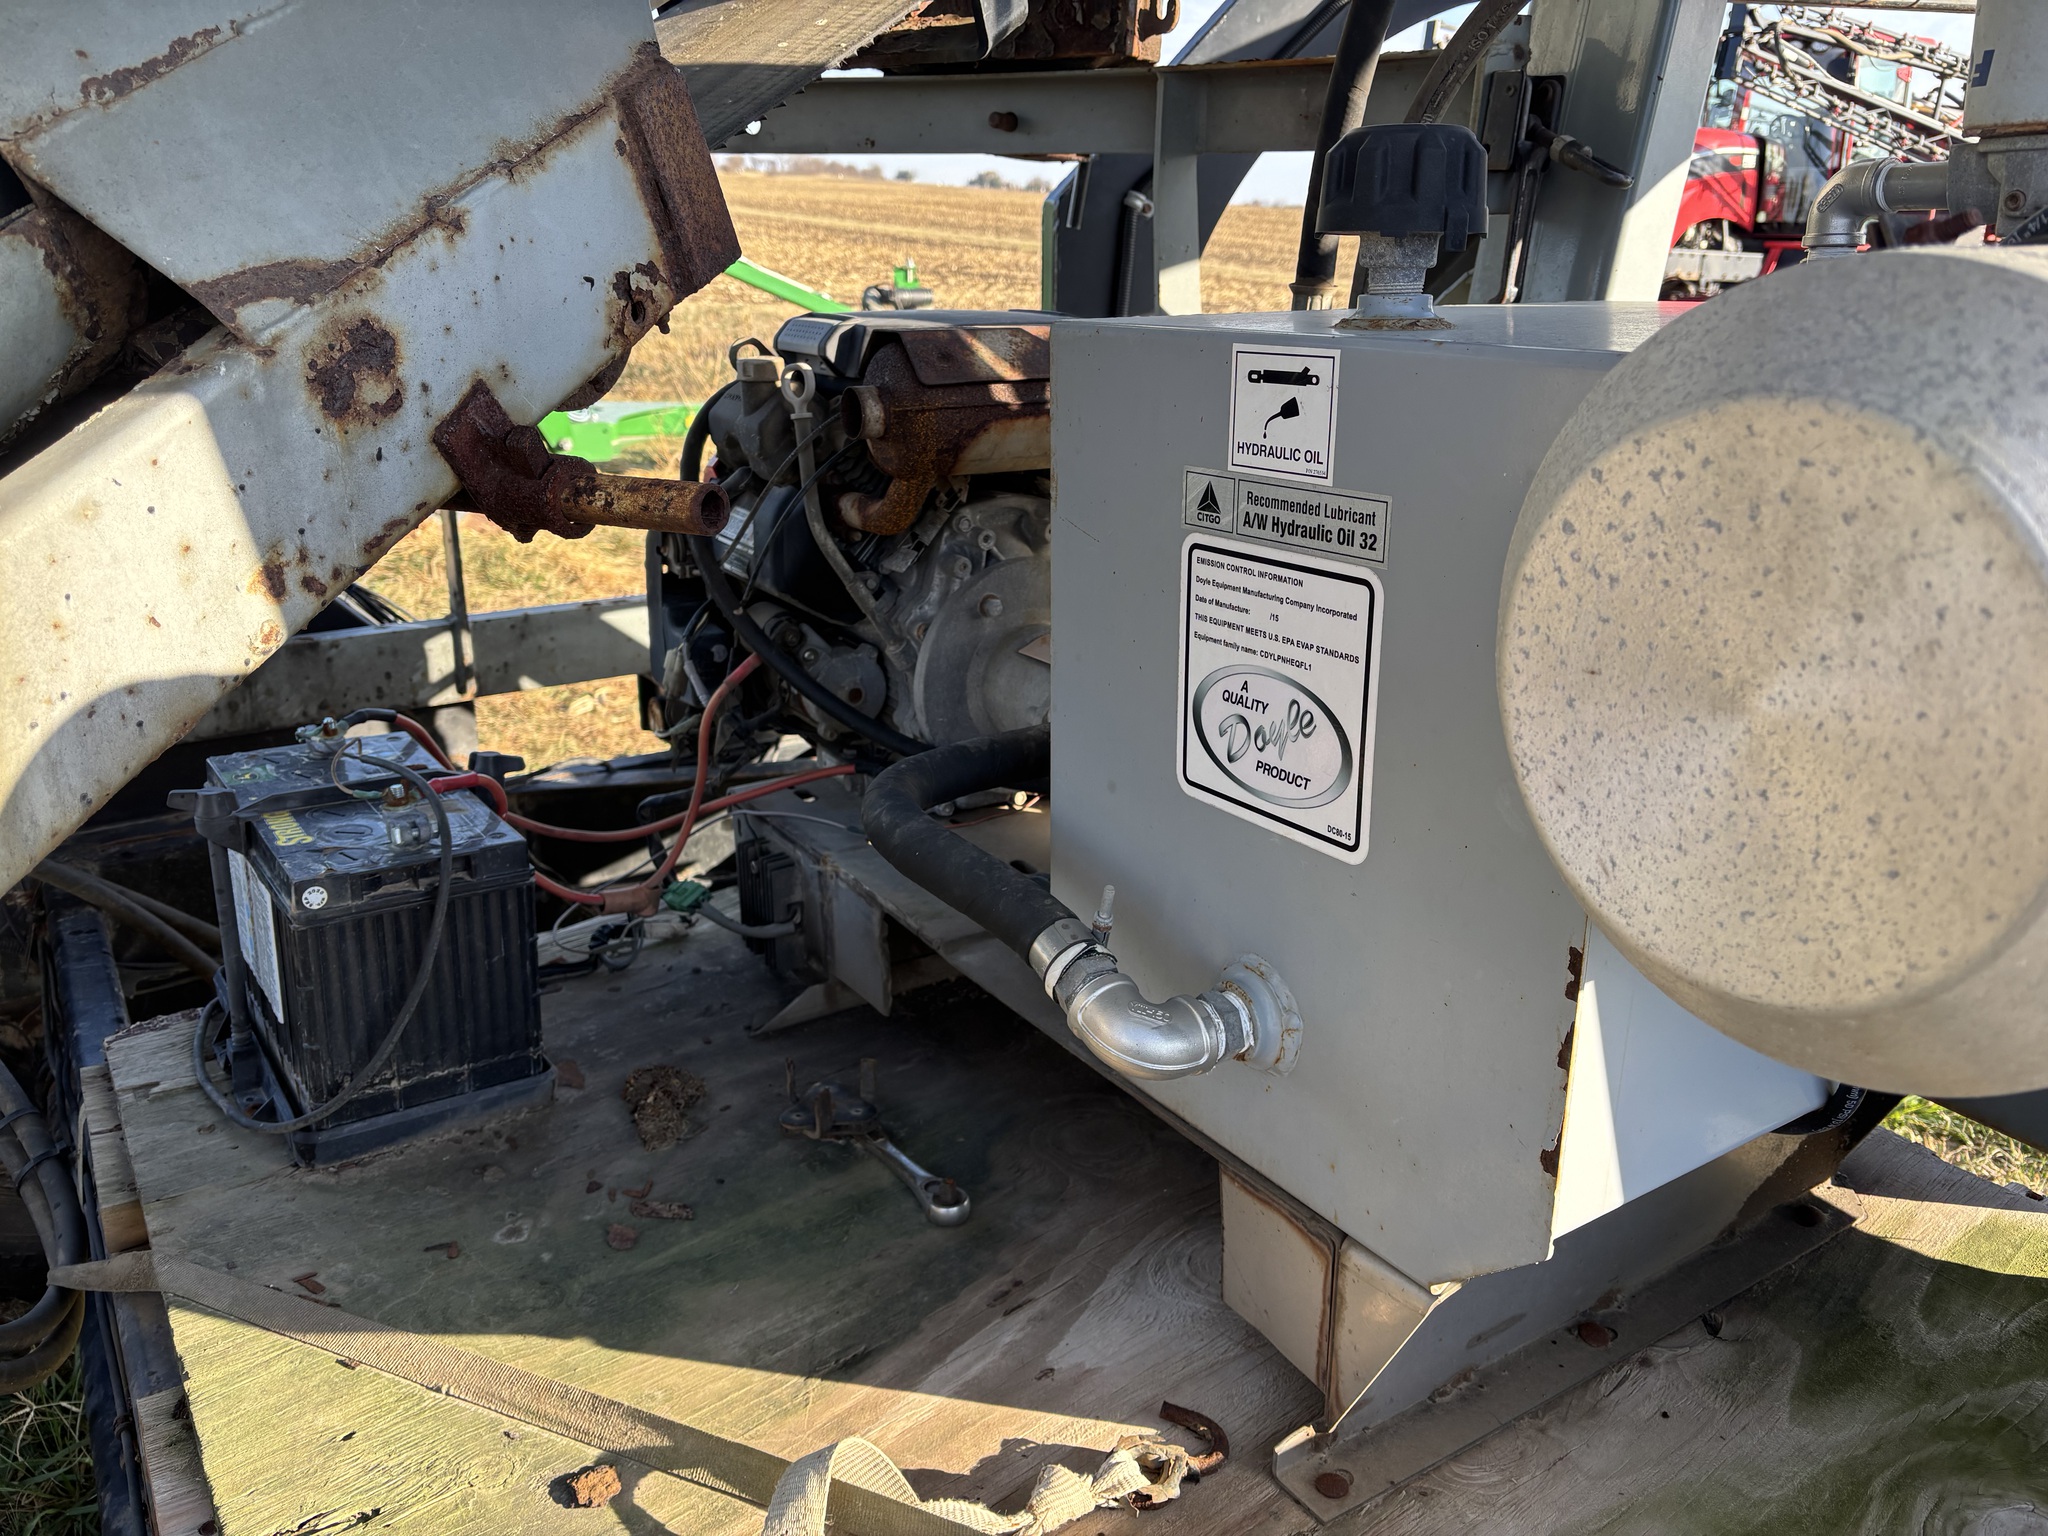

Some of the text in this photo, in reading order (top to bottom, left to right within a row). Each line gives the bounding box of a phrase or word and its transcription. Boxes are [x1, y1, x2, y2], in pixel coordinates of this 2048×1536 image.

[1237, 441, 1324, 465] HYDRAULIC OIL
[1196, 512, 1221, 525] CITGO
[1246, 490, 1376, 527] Recommended Lubricant
[1242, 511, 1378, 552] A/W Hydraulic Oil 32
[1196, 556, 1304, 587] EMISSION CONTROL INFORMATION
[1195, 575, 1358, 621] Doyle Equipment Manufacturing Company Incorporated
[1195, 594, 1280, 622] Date of Manufacture: /15
[1193, 631, 1223, 646] Equipment
[1222, 639, 1240, 652] family
[1240, 646, 1259, 656] name:
[1194, 612, 1360, 664] THIS EQUIPMENT MEETS U.S. EPA EVAP STANDARDS
[1240, 680, 1249, 693] A
[1222, 689, 1269, 715] QUALITY
[1218, 698, 1317, 764] Doyle
[1255, 760, 1311, 790] PRODUCT
[1327, 824, 1352, 842] DC80-15
